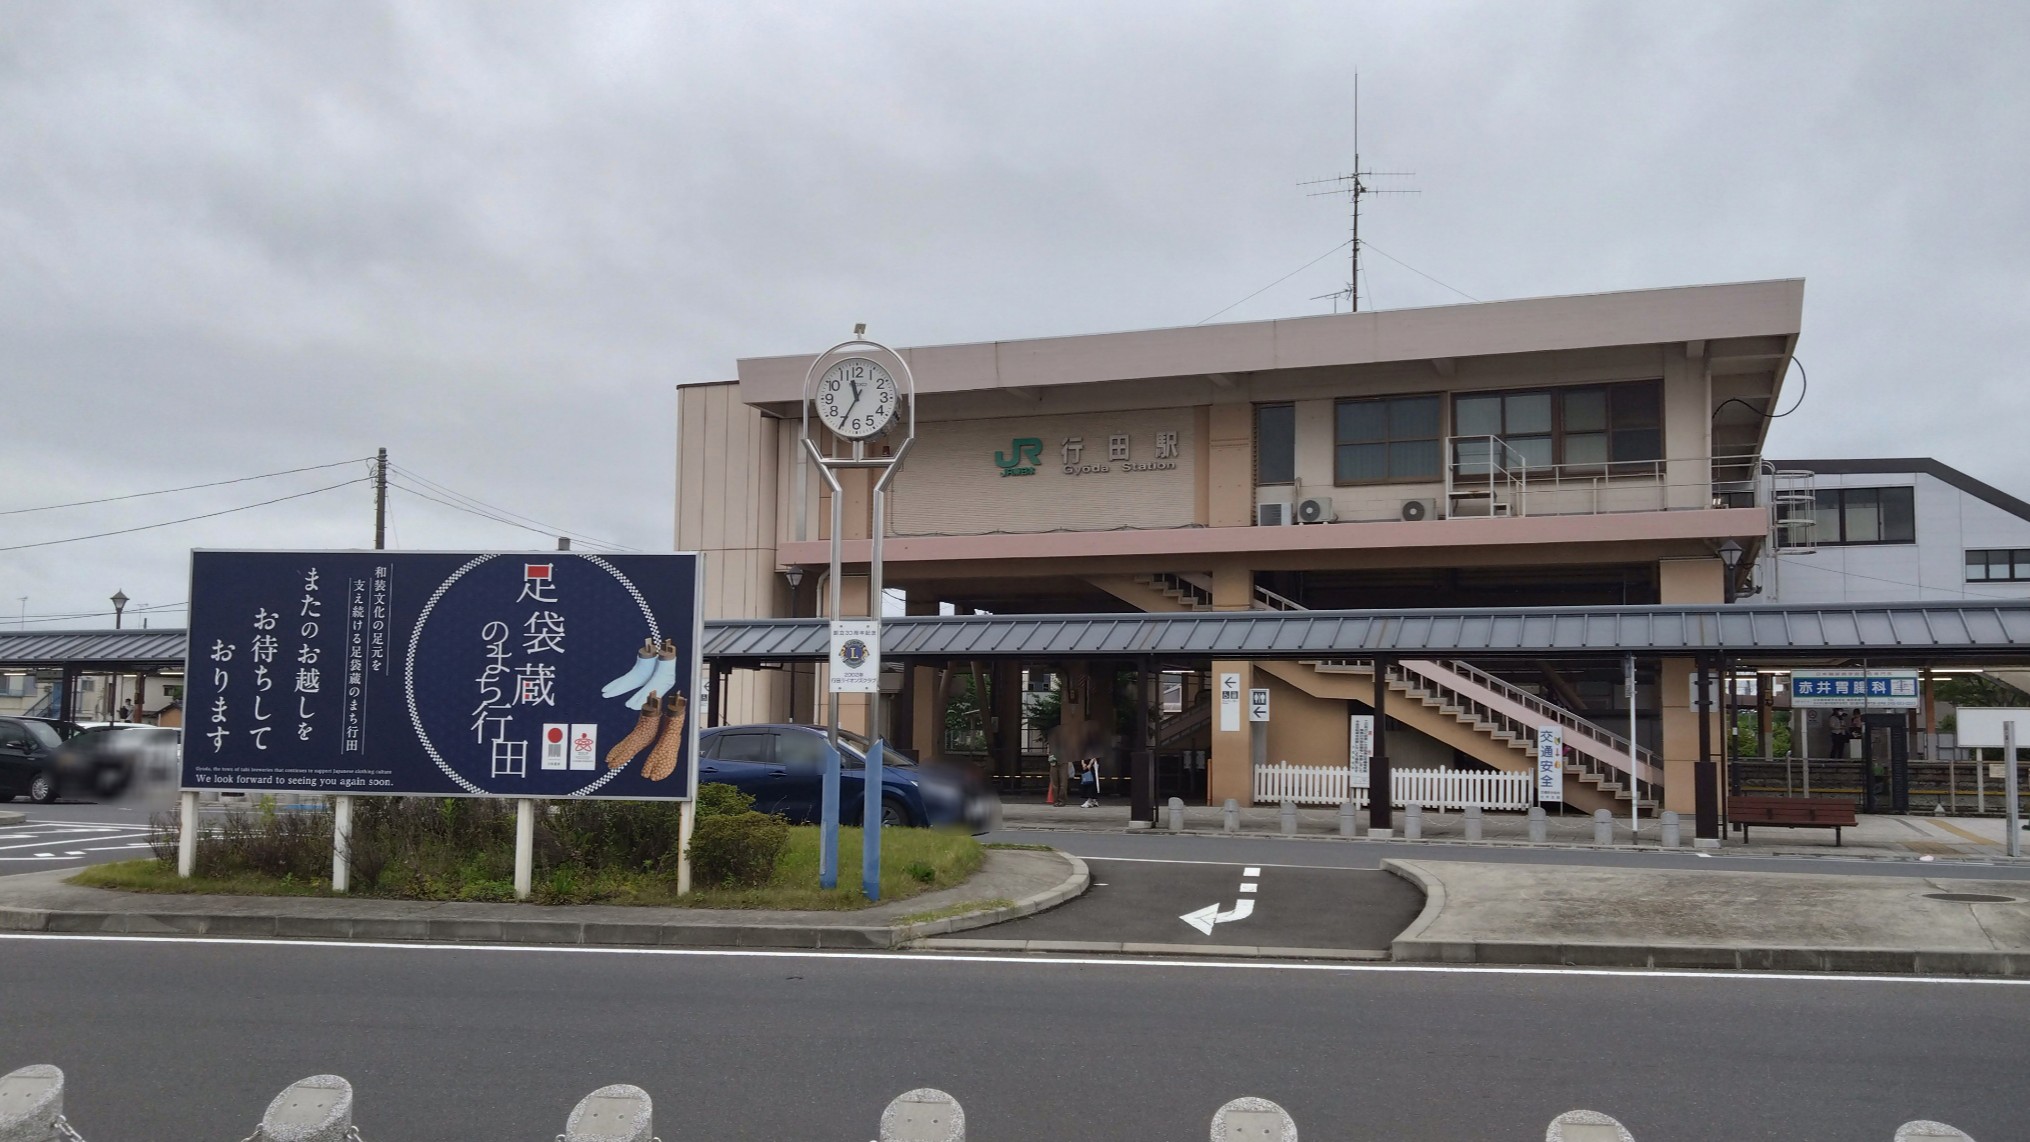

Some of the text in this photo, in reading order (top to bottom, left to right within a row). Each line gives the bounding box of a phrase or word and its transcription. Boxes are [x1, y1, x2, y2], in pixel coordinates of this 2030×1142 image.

[840, 370, 849, 381] 11
[852, 366, 863, 378] 12
[828, 380, 840, 391] 10
[876, 378, 885, 389] 2
[825, 393, 834, 404] 9
[879, 392, 888, 403] 3
[829, 405, 838, 416] 8
[875, 405, 884, 416] 4
[852, 418, 861, 430] 6
[865, 415, 874, 426] 5
[995, 437, 1043, 468] JR
[1060, 430, 1178, 465] 行田駅
[1121, 461, 1177, 472] Station
[371, 566, 387, 671] 和装文化の足元を
[511, 562, 566, 707] 足袋蔵
[294, 567, 321, 741] またのお越しを
[850, 647, 859, 659] L
[346, 579, 366, 752] 支え続ける足袋蔵のまち行田
[249, 607, 280, 750] お待ちして
[1798, 680, 1887, 695] 赤井胃腸科
[206, 639, 236, 754] おります
[1539, 730, 1554, 788] 交通安全
[195, 774, 394, 788] We look forward to seeing you again soon.
